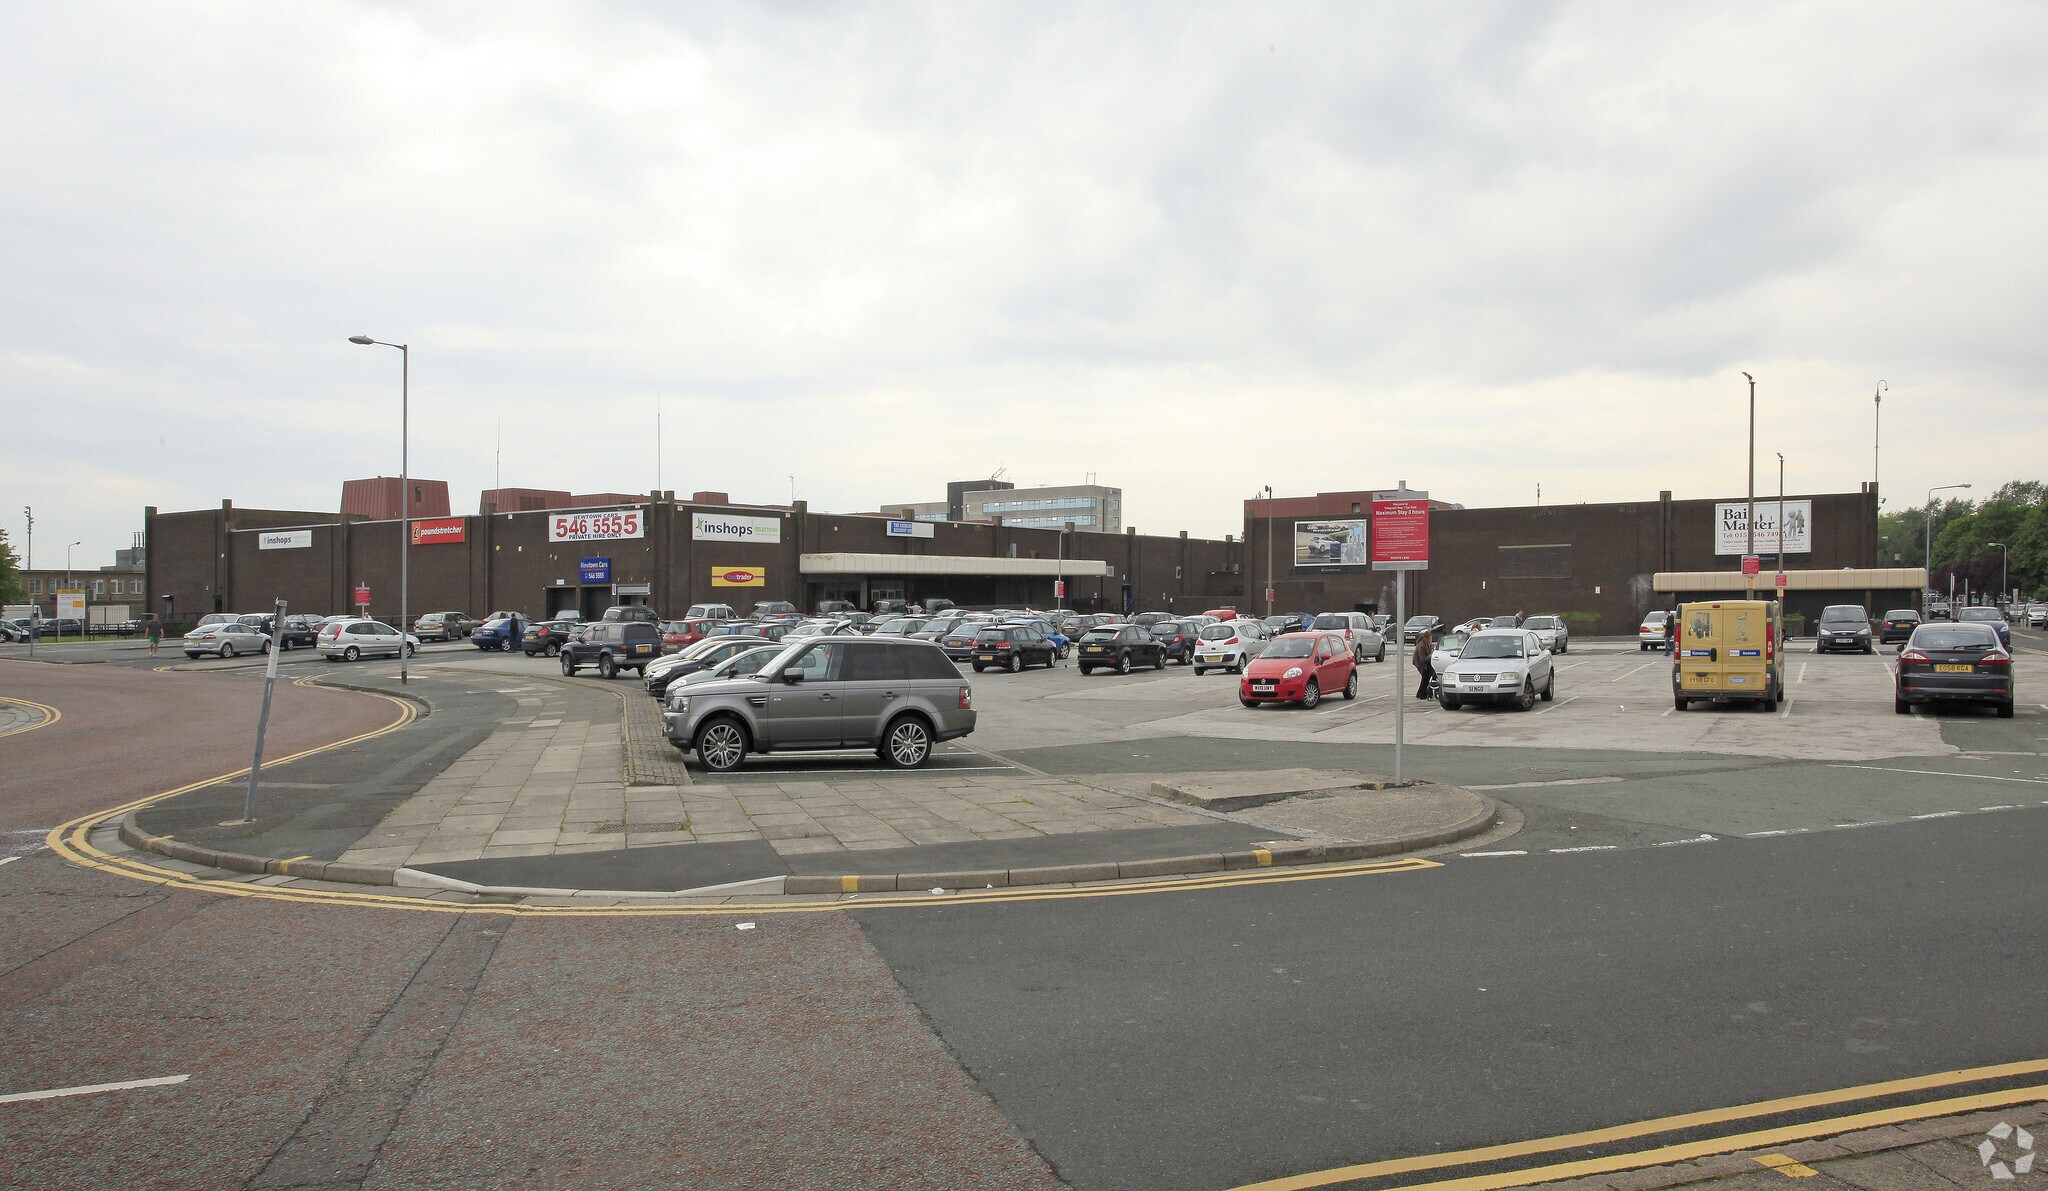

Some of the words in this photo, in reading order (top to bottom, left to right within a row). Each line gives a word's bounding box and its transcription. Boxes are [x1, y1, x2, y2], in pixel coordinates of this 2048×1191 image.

[1723, 508, 1748, 520] Bai
[556, 518, 587, 537] 546
[594, 514, 637, 534] 5555
[704, 521, 752, 537] inshops
[1723, 520, 1774, 531] Mater
[421, 526, 462, 538] poundstretcher
[267, 536, 292, 544] inshops
